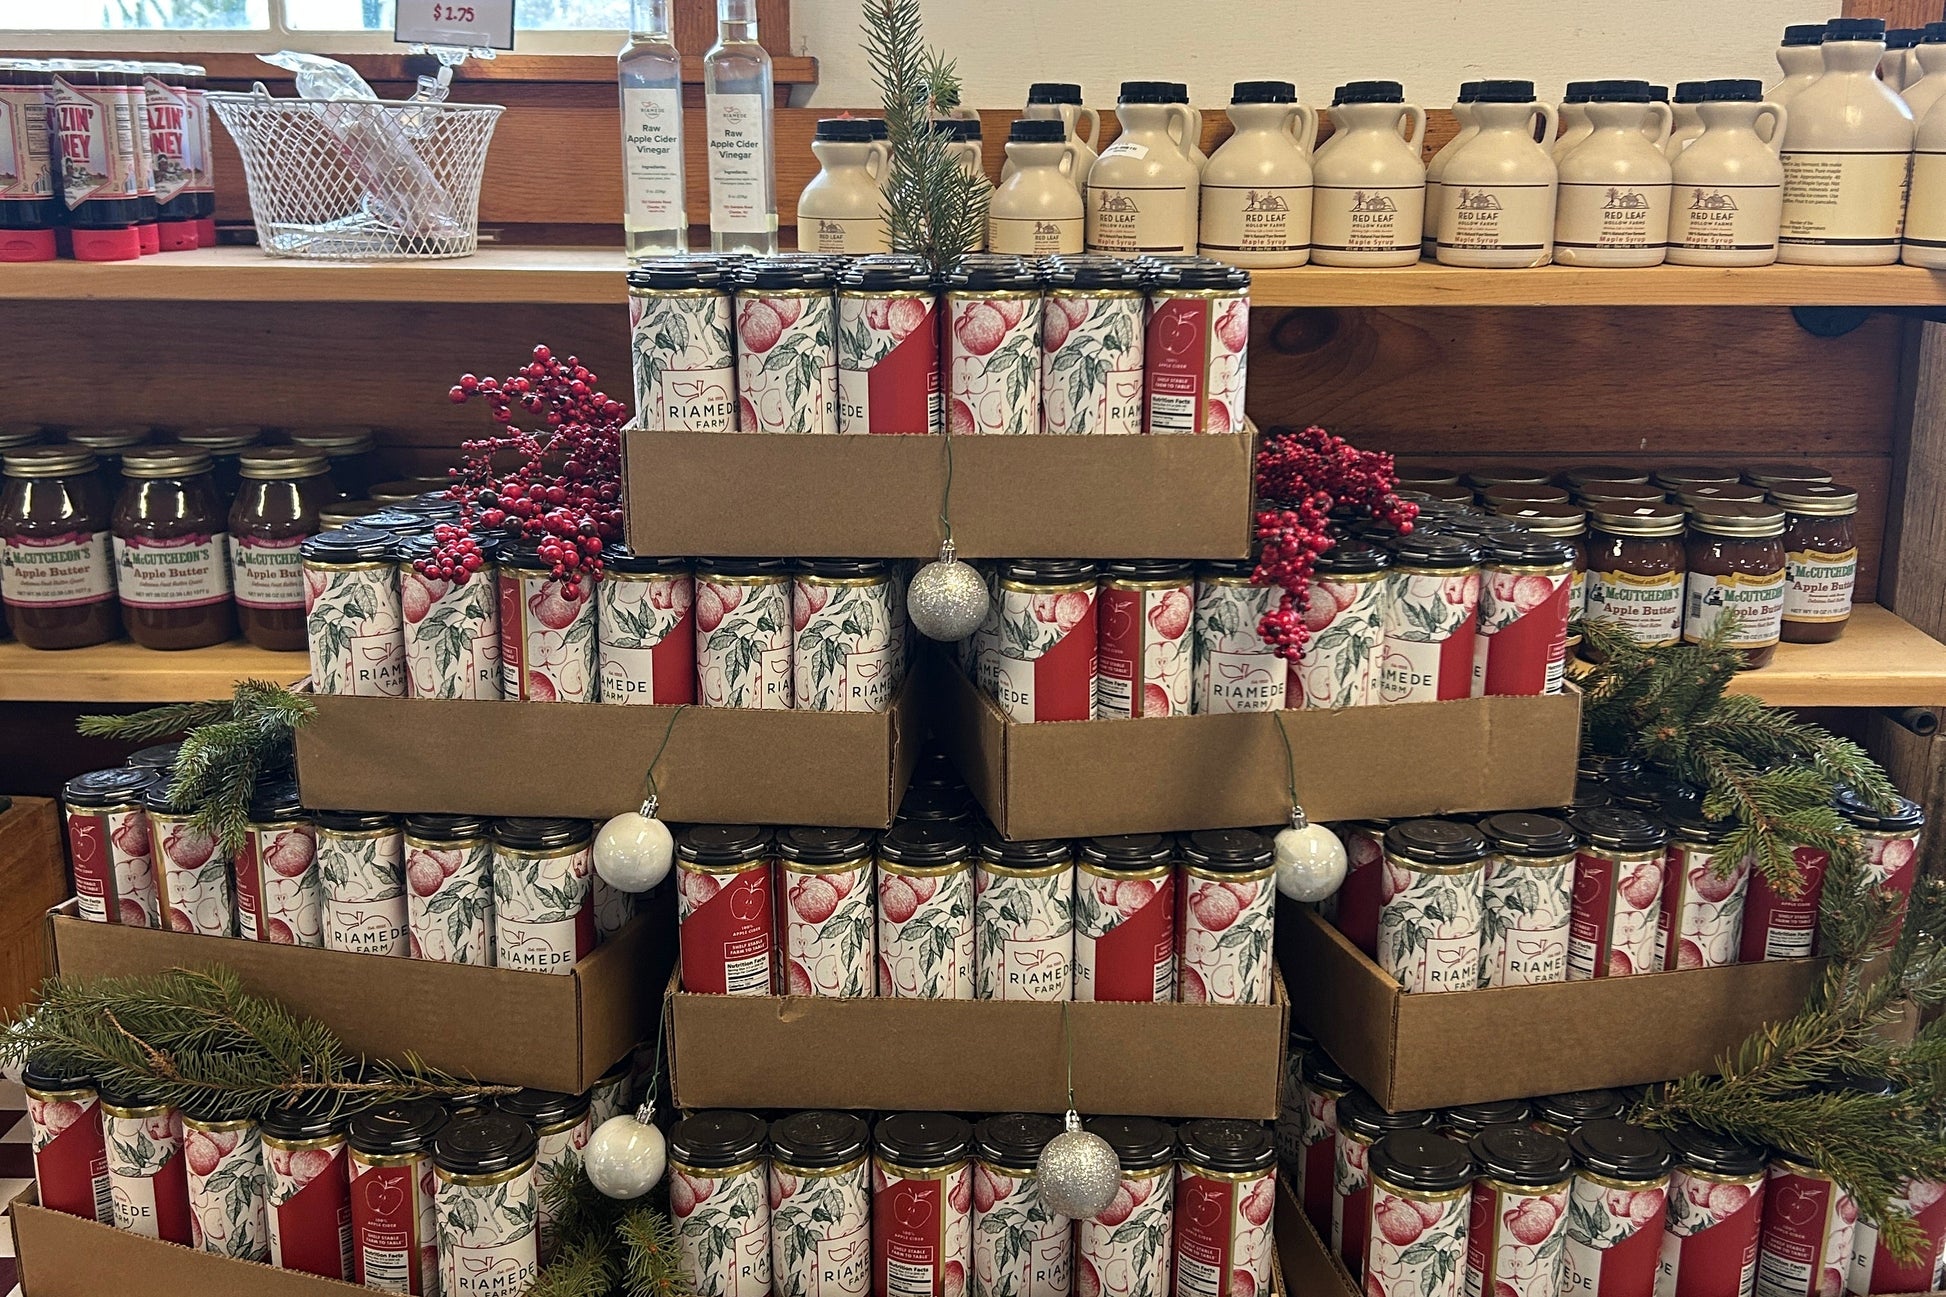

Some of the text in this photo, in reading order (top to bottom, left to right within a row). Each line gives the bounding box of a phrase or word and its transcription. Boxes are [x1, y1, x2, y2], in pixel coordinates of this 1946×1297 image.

[433, 3, 475, 22] $ 1.75
[60, 106, 94, 132] ZIN'
[642, 124, 661, 132] Raw
[725, 129, 743, 138] Raw
[152, 132, 183, 154] NEY
[627, 135, 677, 144] Apple Cider
[710, 140, 759, 149] Apple Cider
[61, 133, 91, 159] NEY
[637, 145, 670, 155] Vinegar
[719, 151, 752, 160] Vinegar
[1100, 214, 1136, 223] RED LEAF
[1246, 214, 1286, 222] RED LEAF
[1352, 214, 1394, 222] RED LEAF
[1458, 211, 1498, 221] RED LEAF
[1604, 211, 1646, 220] RED LEAF
[1690, 212, 1733, 221] RED LEAF
[1455, 236, 1498, 245] Maple Syrup
[1111, 405, 1142, 419] RIAM
[695, 418, 726, 429] FARM
[13, 548, 91, 565] McCUTCHEON'S
[132, 549, 210, 565] McCUTCHEON'S
[245, 552, 303, 566] McCUTCHEO
[15, 565, 91, 579] Apple Butter
[133, 567, 209, 580] Apple Butter
[246, 568, 303, 580] Apple But
[1792, 581, 1828, 593] Apple
[1606, 586, 1680, 602] McCUTCHEON'S
[1603, 602, 1677, 617] Apple Butter
[360, 665, 402, 681] RIAM
[386, 677, 404, 688] FAR
[601, 675, 647, 692] AMEDE
[852, 678, 891, 698] RIAME
[1380, 681, 1406, 693] FARM
[603, 690, 624, 701] FARM
[1213, 682, 1284, 698] RIAMEDE
[1237, 700, 1268, 709] FARM
[335, 924, 408, 943] RIAMEDE
[356, 943, 389, 954] FARM
[747, 939, 763, 947] STABLE
[500, 947, 571, 965] RIAMEDE
[727, 956, 767, 969] Nutrition Facts
[1511, 955, 1565, 973] RIAME
[1431, 962, 1477, 982] RIAME
[1535, 971, 1560, 982] FARM
[1034, 982, 1062, 994] FARM
[114, 1201, 150, 1217] MEDE
[894, 1232, 908, 1240] APPLE
[365, 1248, 388, 1258] Nutrition
[1200, 1251, 1216, 1260] TABLE
[888, 1261, 913, 1272] Nutrition
[1179, 1254, 1216, 1274] Nutrition Facts
[1763, 1252, 1806, 1271] Nutrition Facts
[825, 1255, 869, 1282] RIAME
[1036, 1258, 1070, 1282] RIAM
[459, 1262, 534, 1288] RIAMEDE
